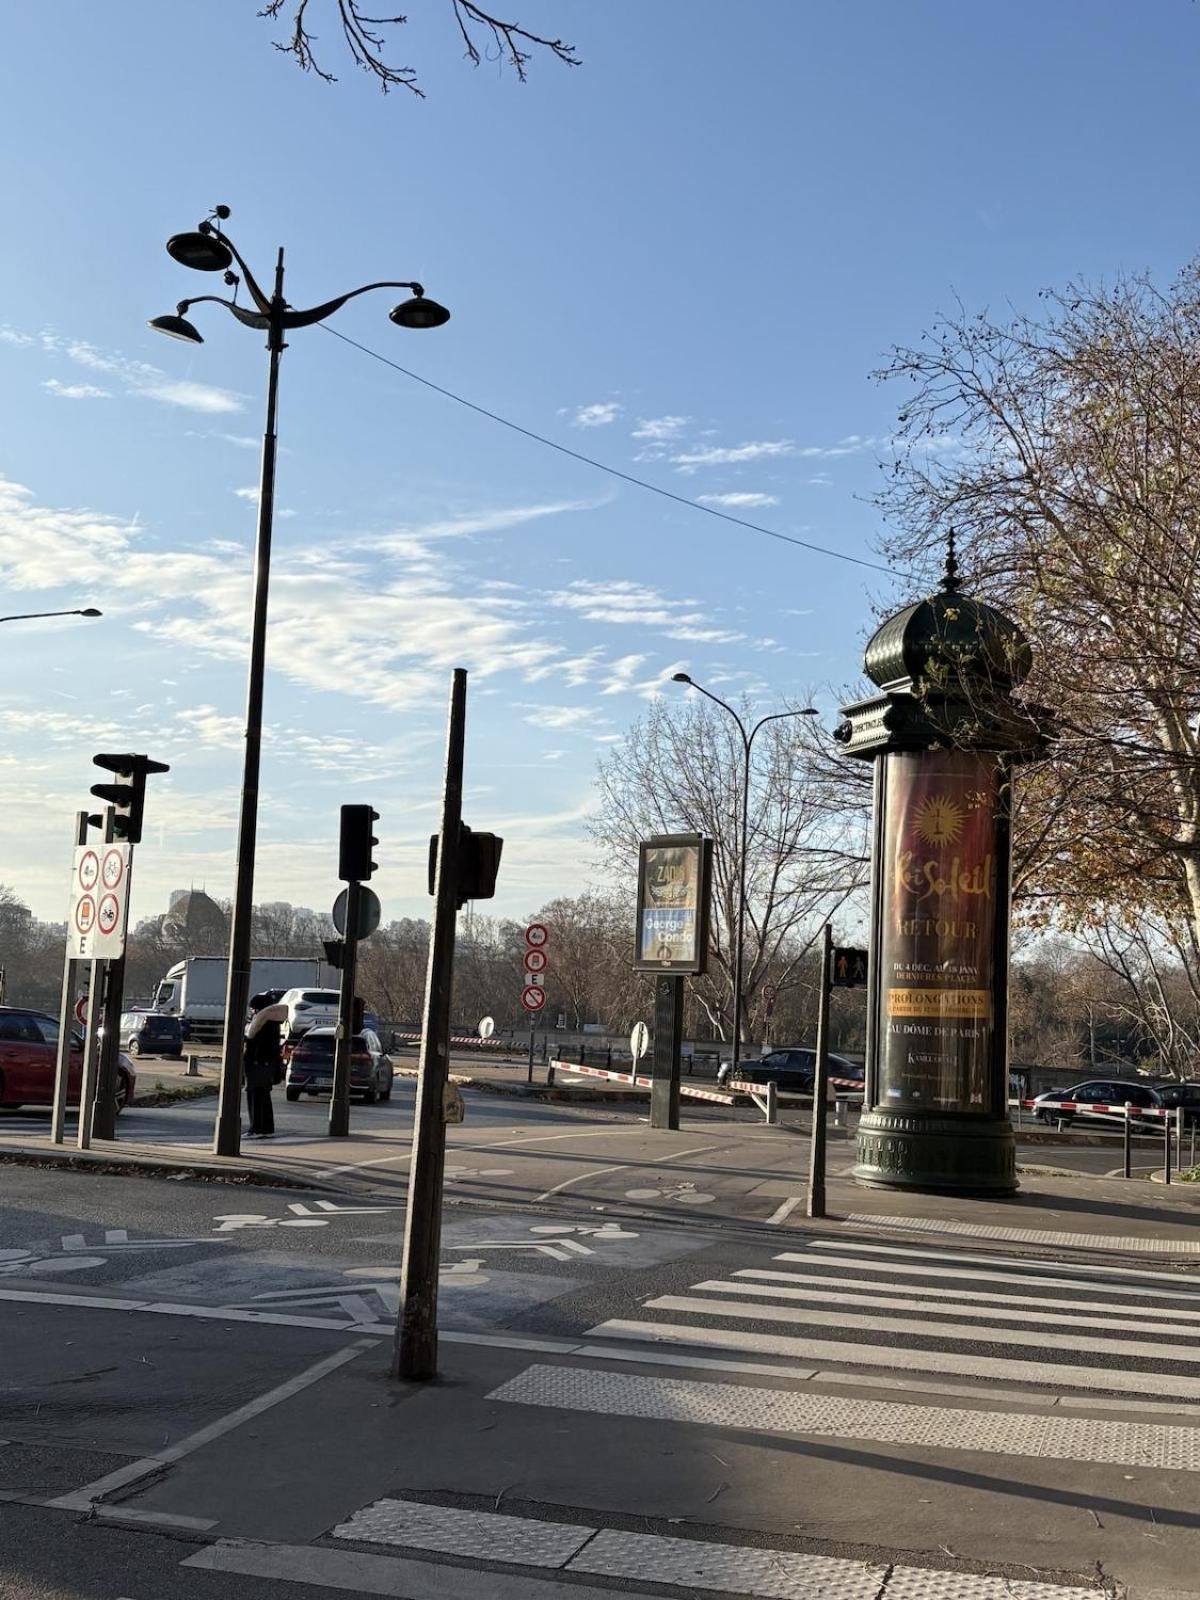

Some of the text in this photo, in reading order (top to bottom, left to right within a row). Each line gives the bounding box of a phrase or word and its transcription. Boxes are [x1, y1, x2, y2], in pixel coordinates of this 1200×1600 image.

[645, 918, 683, 931] George
[896, 919, 977, 938] RETOUR
[658, 931, 693, 943] Condo
[79, 936, 86, 954] E
[531, 974, 538, 985] E
[889, 992, 984, 1005] PROLONGAIONS
[891, 1023, 980, 1039] AU DÔME DE PARIS
